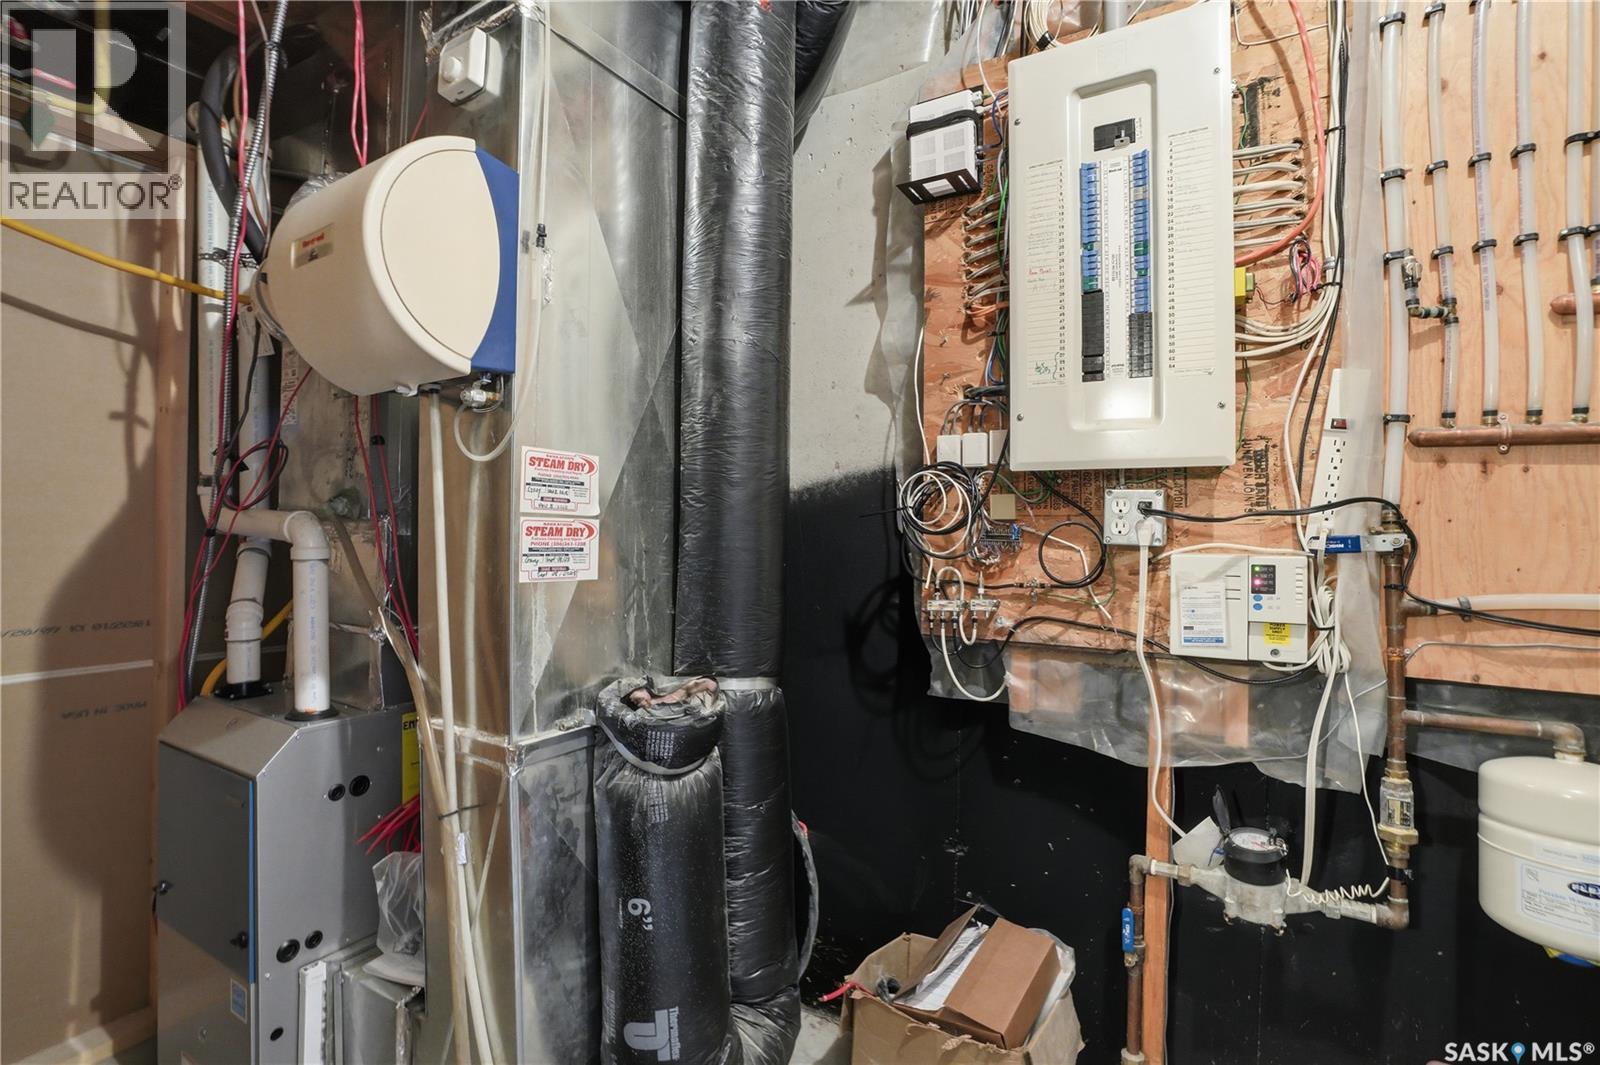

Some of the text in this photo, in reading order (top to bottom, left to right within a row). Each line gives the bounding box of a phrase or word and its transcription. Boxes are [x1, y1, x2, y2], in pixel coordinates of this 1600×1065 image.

[528, 456, 566, 471] STEAM
[567, 461, 587, 472] DRY
[1242, 442, 1256, 512] UNEVEN JOINTS
[524, 526, 586, 538] STEAM DRY
[402, 718, 419, 731] EN
